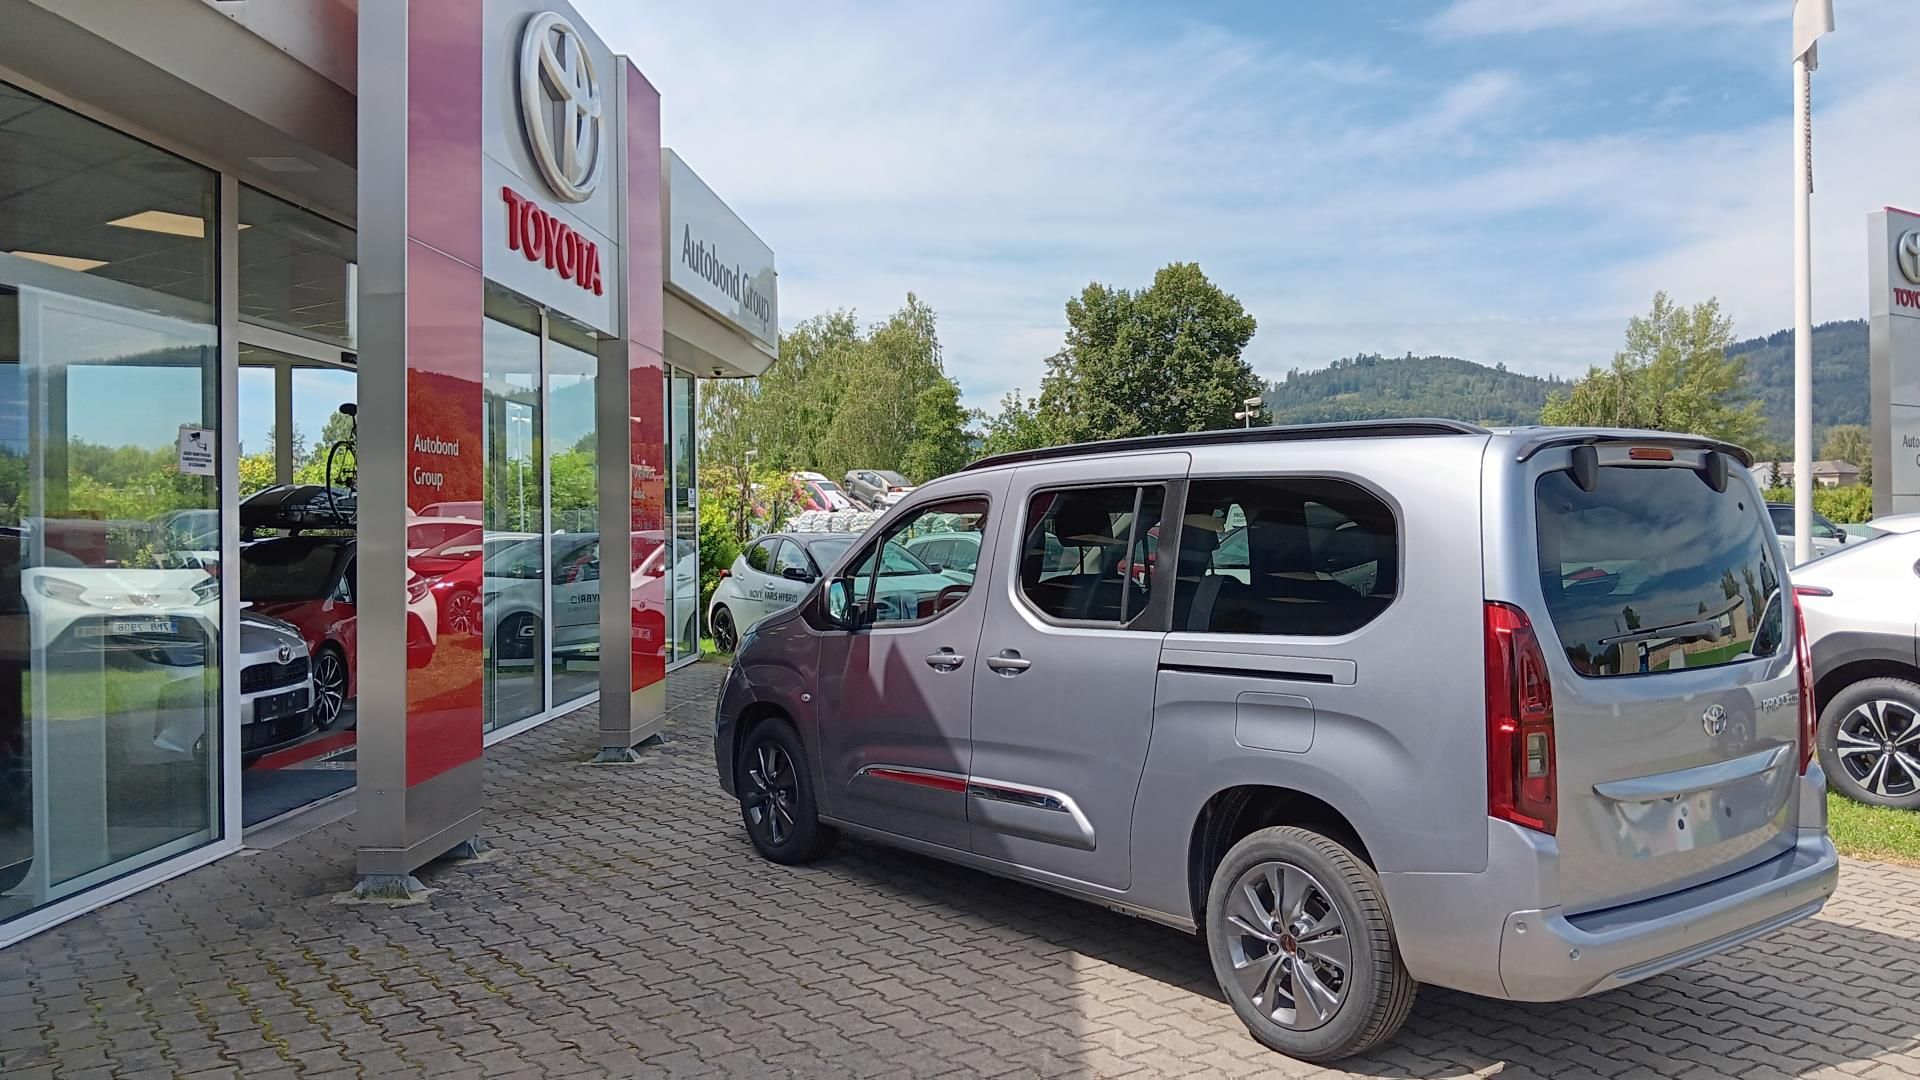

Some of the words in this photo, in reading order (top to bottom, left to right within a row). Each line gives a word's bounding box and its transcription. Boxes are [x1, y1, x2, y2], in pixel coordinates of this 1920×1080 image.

[501, 185, 604, 297] TOYOTA
[682, 223, 740, 303] Autobond
[742, 272, 770, 333] Group
[413, 433, 459, 457] Autobond
[413, 466, 444, 492] Group
[778, 592, 798, 604] HYBRID
